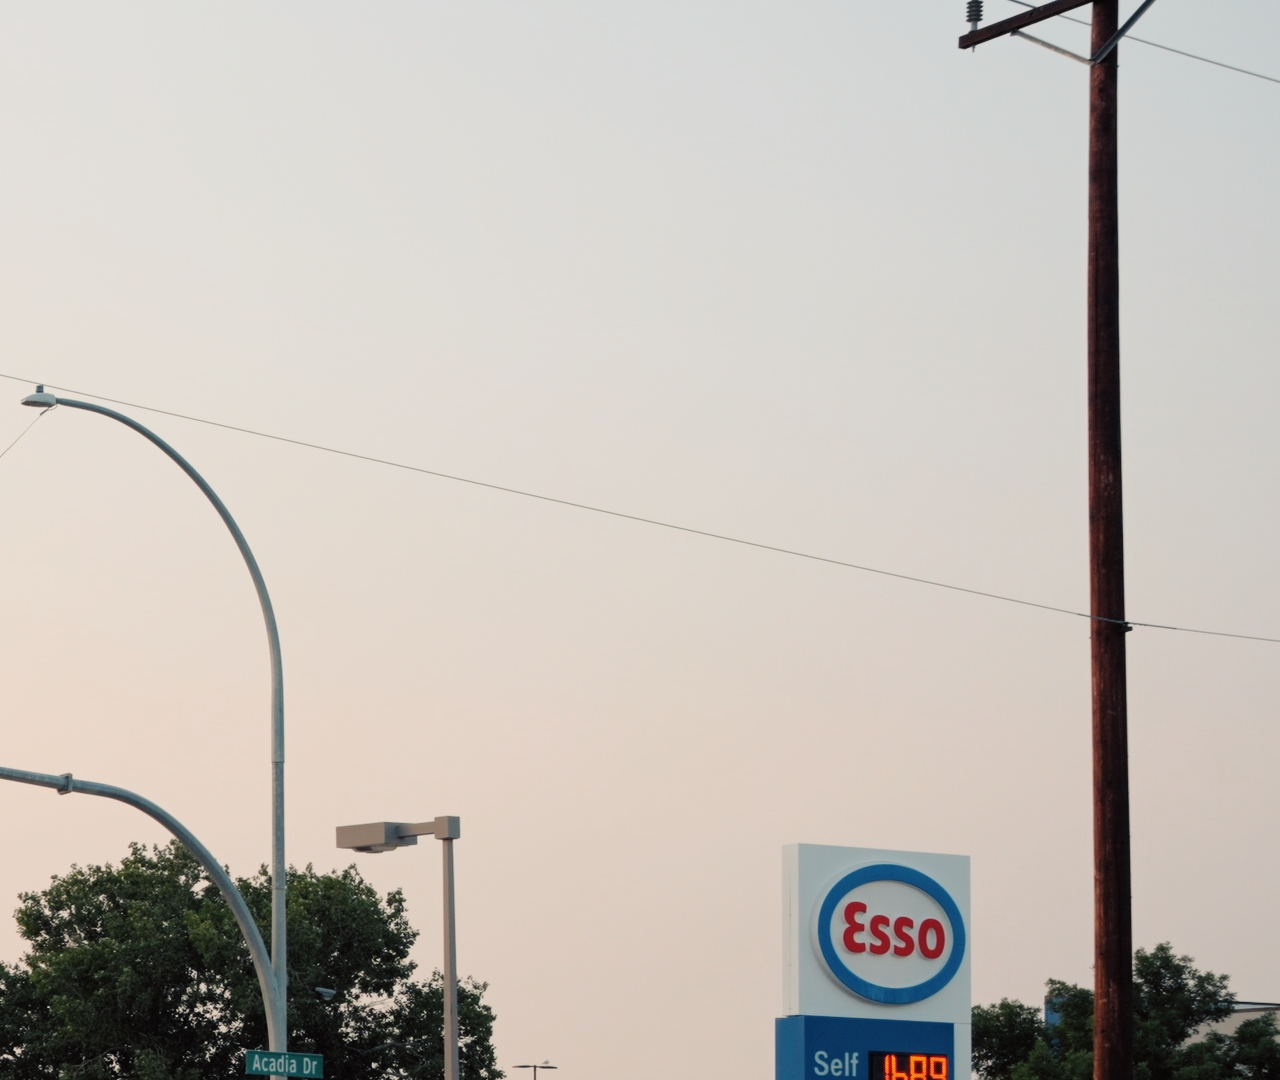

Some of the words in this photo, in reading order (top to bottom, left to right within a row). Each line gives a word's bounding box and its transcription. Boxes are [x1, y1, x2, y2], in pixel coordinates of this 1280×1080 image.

[842, 900, 946, 960] Esso
[252, 1054, 297, 1073] Acadia
[303, 1057, 318, 1075] Dr
[814, 1050, 859, 1077] Self
